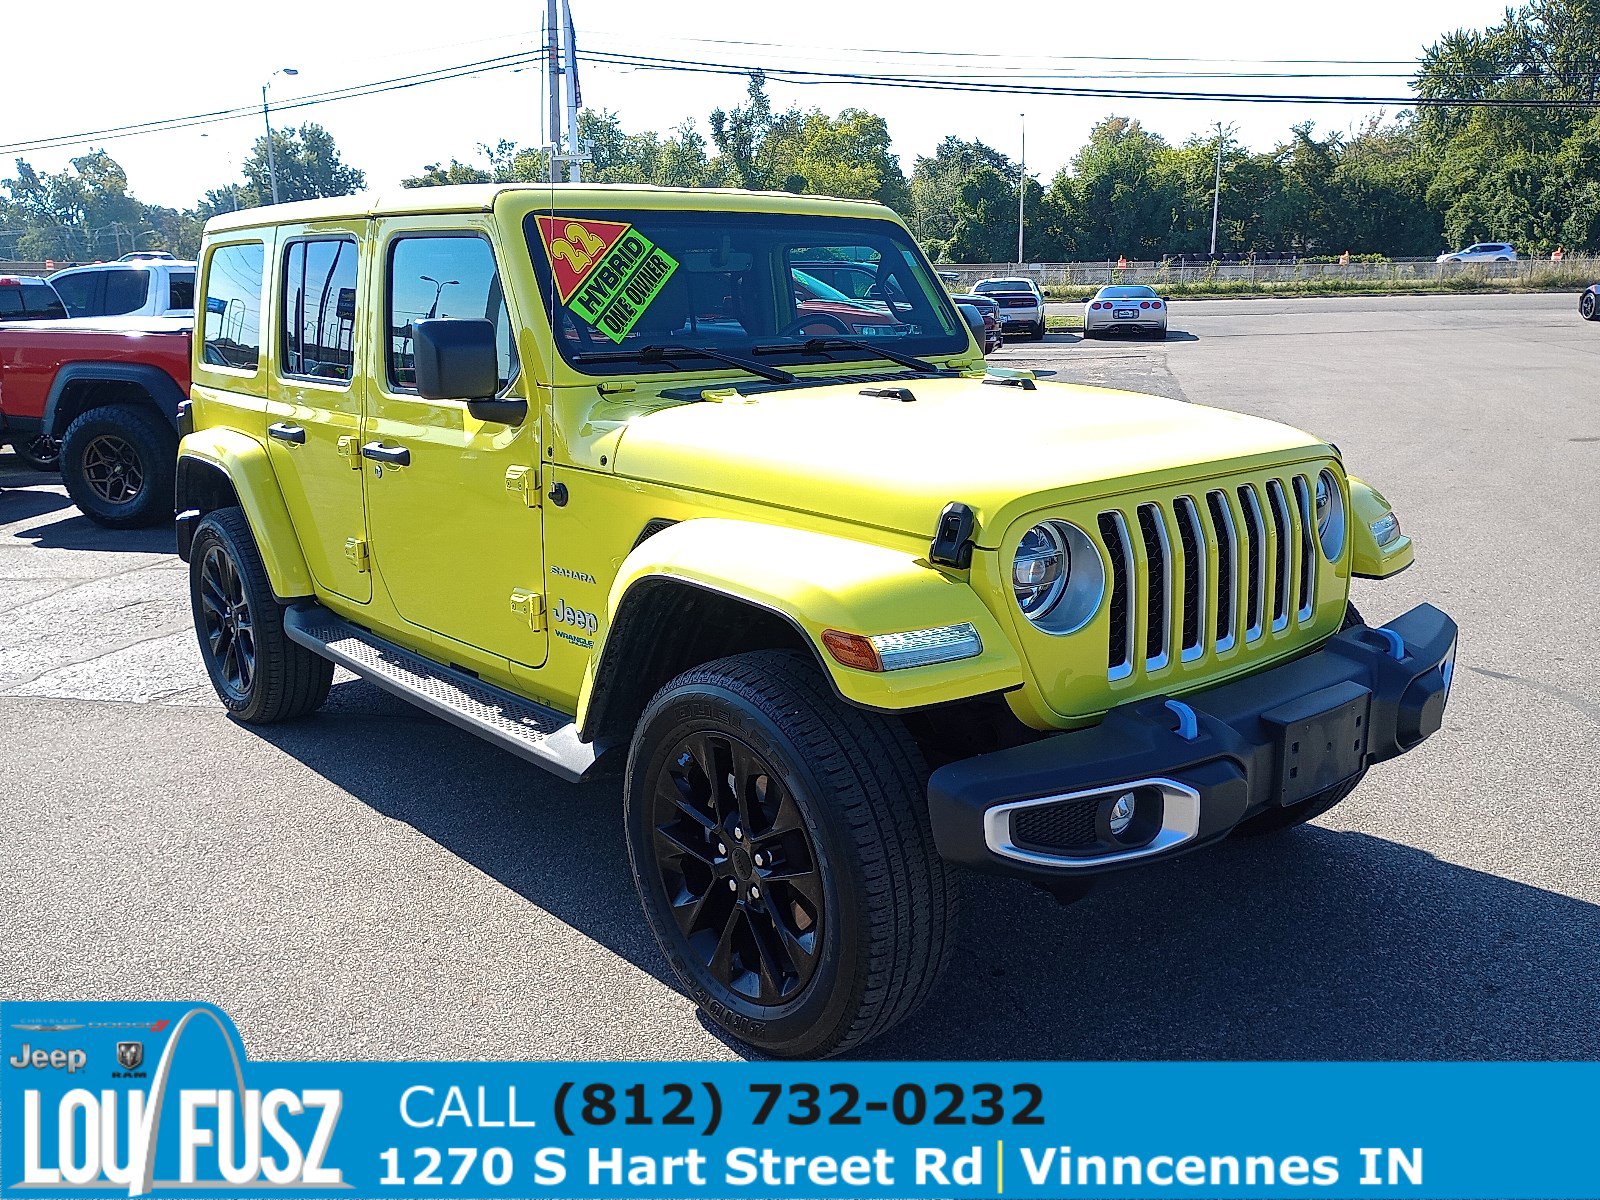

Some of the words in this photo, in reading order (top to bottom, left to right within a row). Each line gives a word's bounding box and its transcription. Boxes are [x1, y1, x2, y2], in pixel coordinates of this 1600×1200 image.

[550, 222, 607, 274] 22
[577, 237, 646, 316] HYBRID
[603, 297, 638, 335] ONE
[625, 254, 672, 306] OWNER
[550, 565, 597, 585] SAHARA
[552, 597, 598, 636] Jeep
